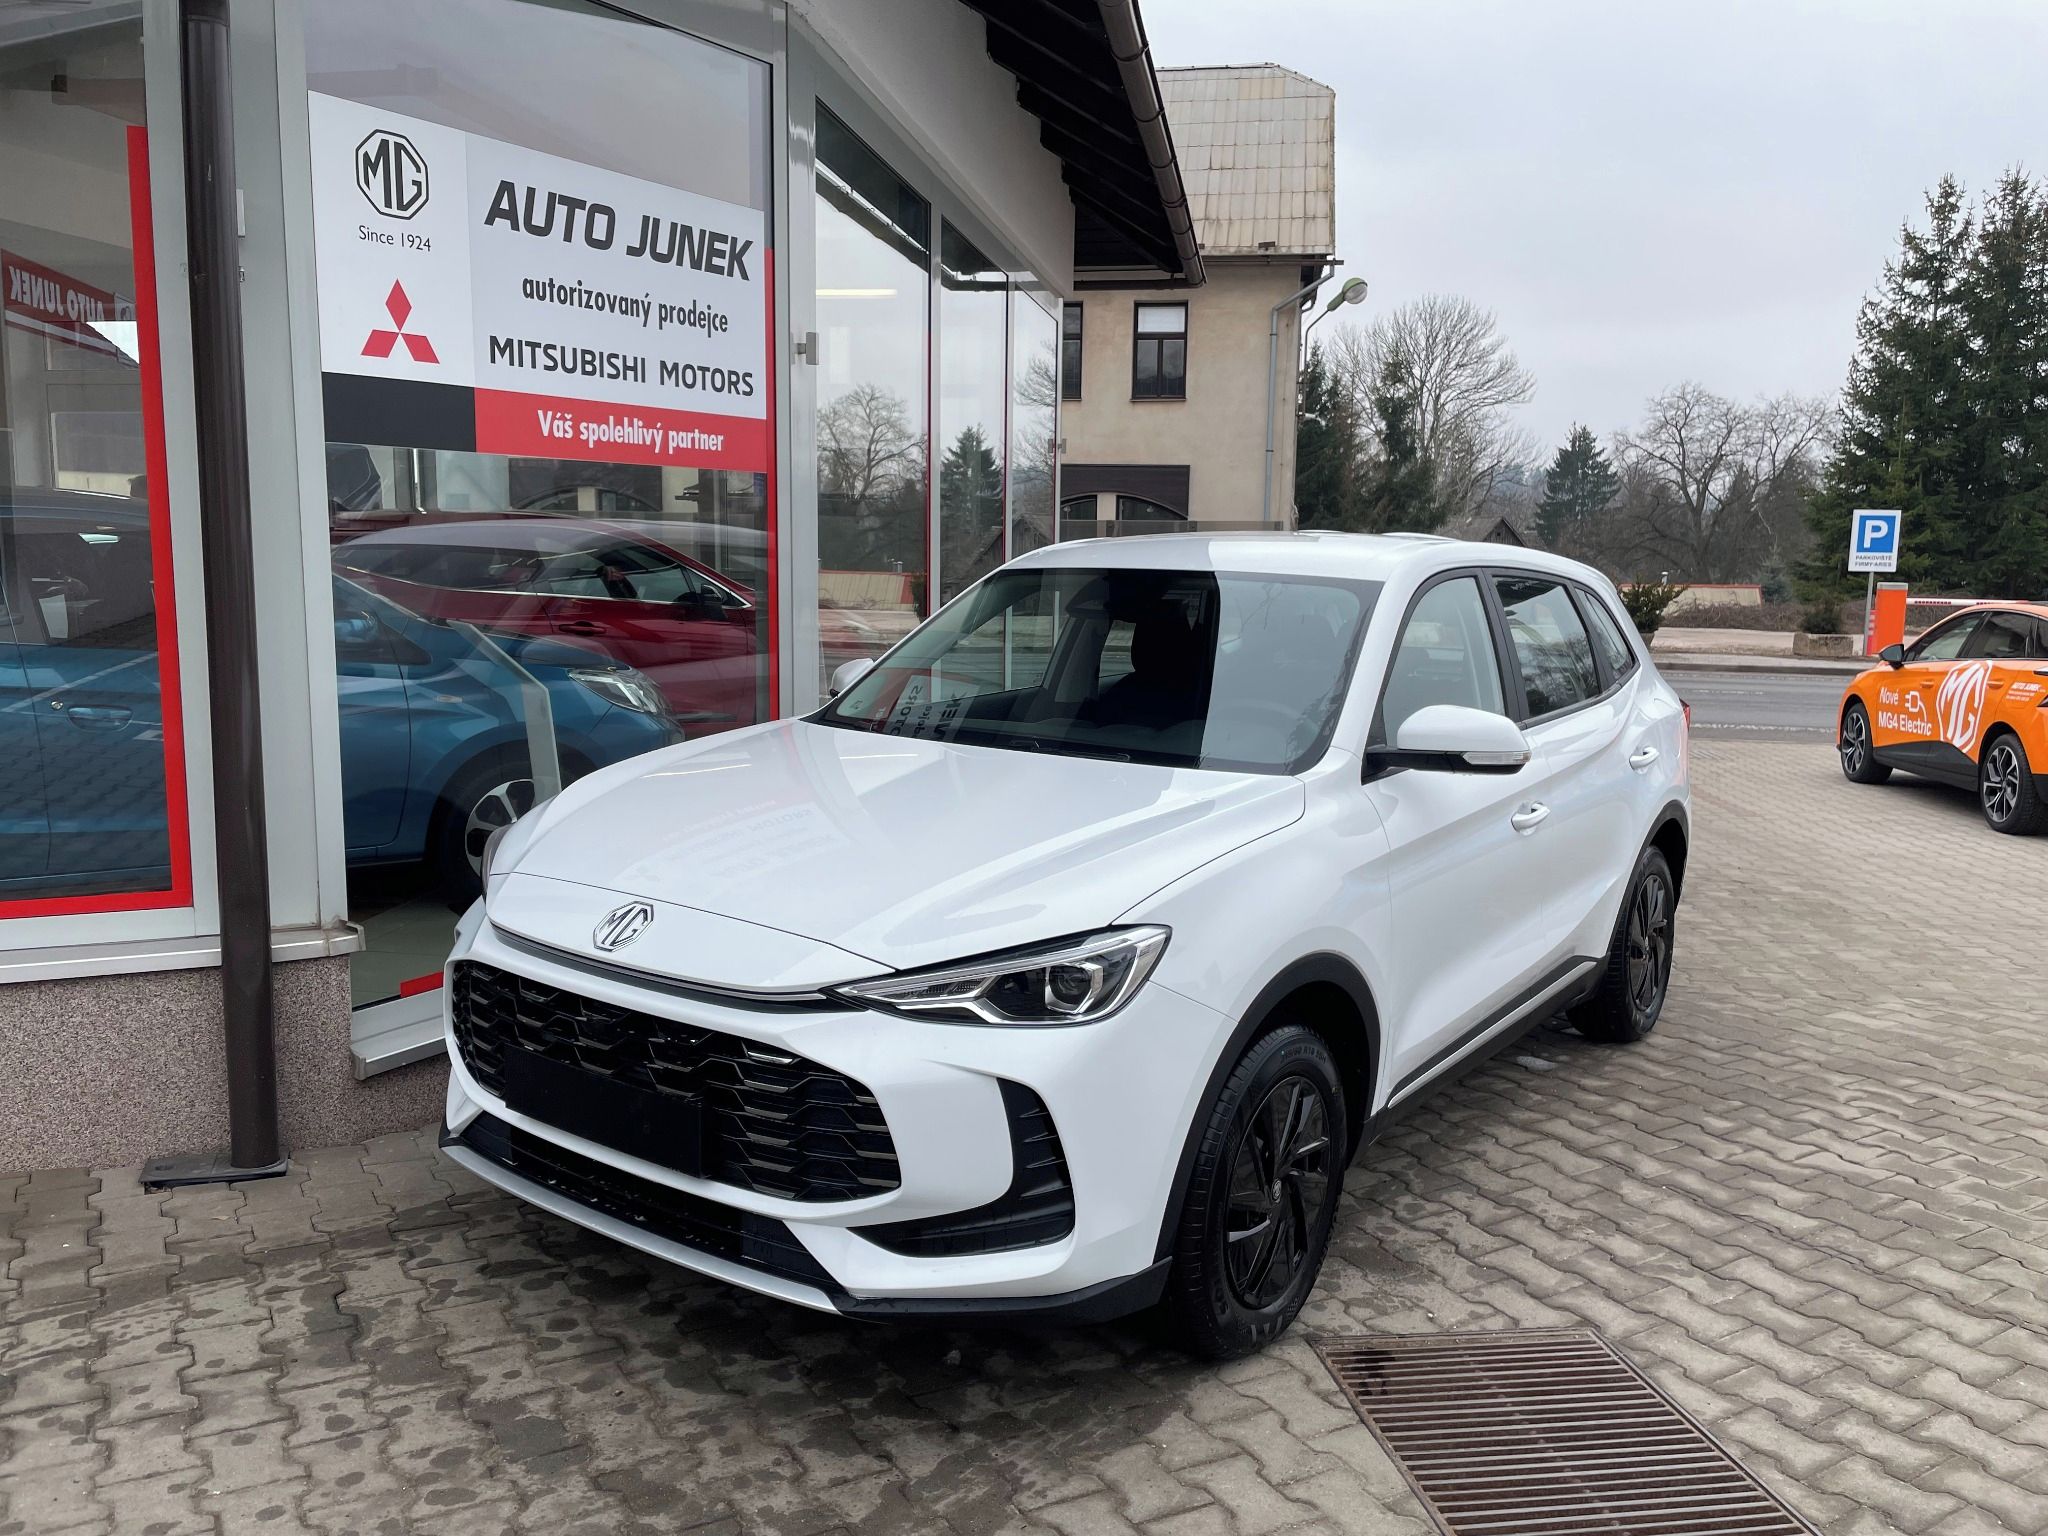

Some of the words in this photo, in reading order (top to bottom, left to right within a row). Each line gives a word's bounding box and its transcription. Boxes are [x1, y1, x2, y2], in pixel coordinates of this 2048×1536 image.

[361, 138, 422, 212] MG
[358, 225, 394, 246] Since
[400, 232, 432, 252] 1924
[484, 179, 616, 251] AUTO
[626, 214, 753, 281] JUNEK
[522, 277, 652, 328] autorizovaný
[658, 298, 729, 338] prodejce
[489, 335, 647, 384] MITSUBISHI
[659, 360, 754, 397] MOTORS
[537, 409, 574, 439] Váš
[579, 414, 664, 454] spolehlivý
[668, 427, 725, 452] partner
[1863, 520, 1888, 549] P
[1880, 687, 1899, 705] Nové
[1878, 711, 1898, 729] MG4
[1899, 713, 1932, 736] Electric
[598, 905, 648, 947] MG
